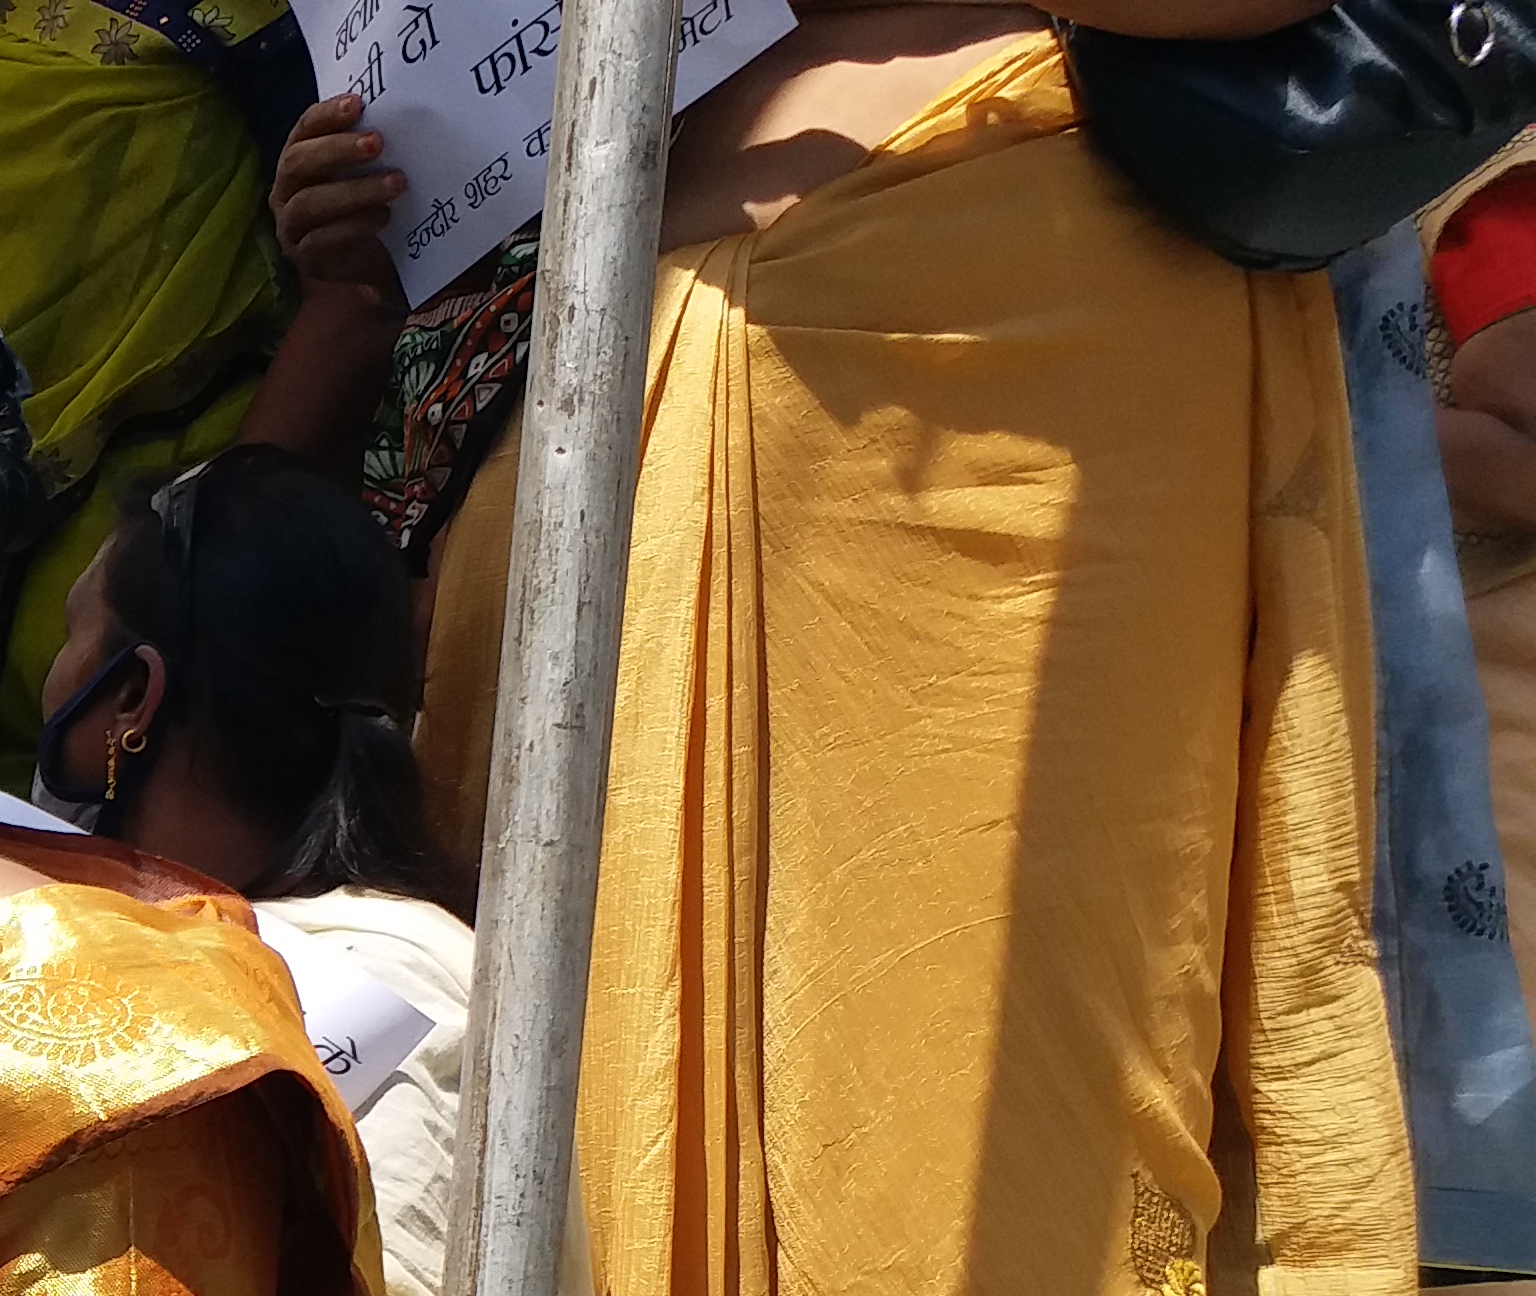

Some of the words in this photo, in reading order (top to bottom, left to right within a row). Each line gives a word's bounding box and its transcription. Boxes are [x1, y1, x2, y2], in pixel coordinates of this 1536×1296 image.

[397, 4, 440, 64] दो
[404, 198, 461, 261] इन्दौर
[462, 150, 513, 210] शहर
